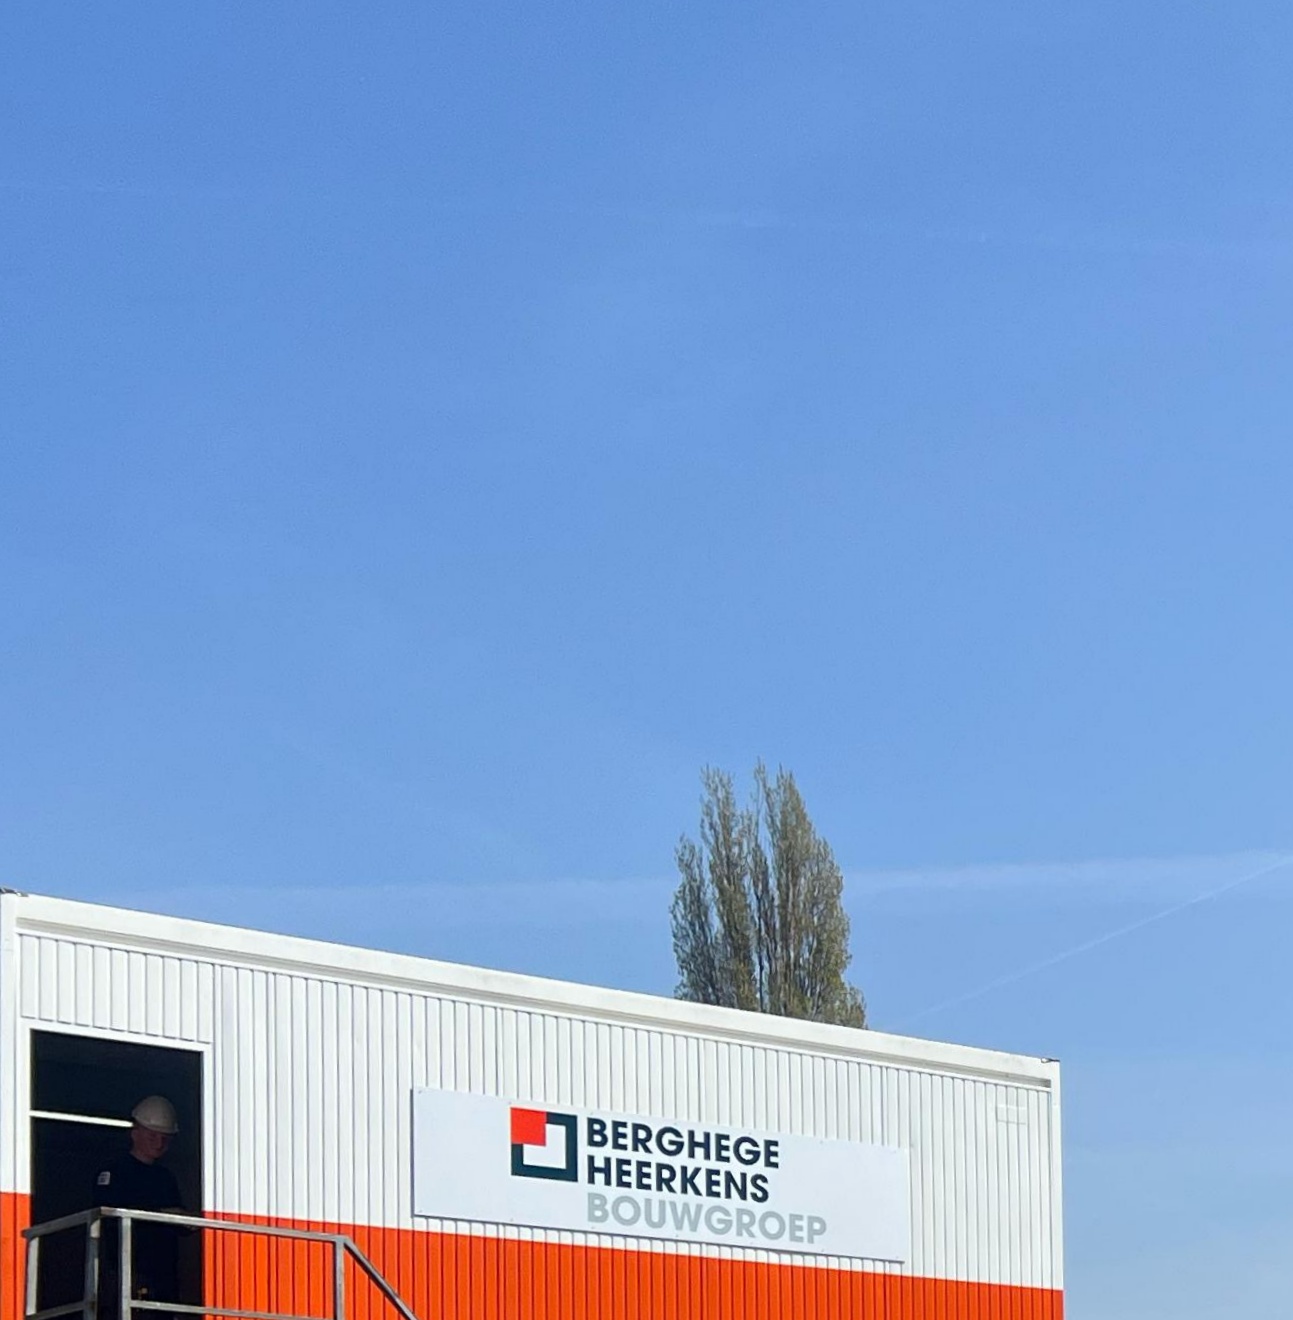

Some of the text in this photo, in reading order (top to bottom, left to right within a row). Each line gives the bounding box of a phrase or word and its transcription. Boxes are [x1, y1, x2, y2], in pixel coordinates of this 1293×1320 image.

[587, 1117, 780, 1169] BERGHEGE
[587, 1155, 770, 1204] HEERKENS
[587, 1192, 827, 1245] BOUWGROEP
